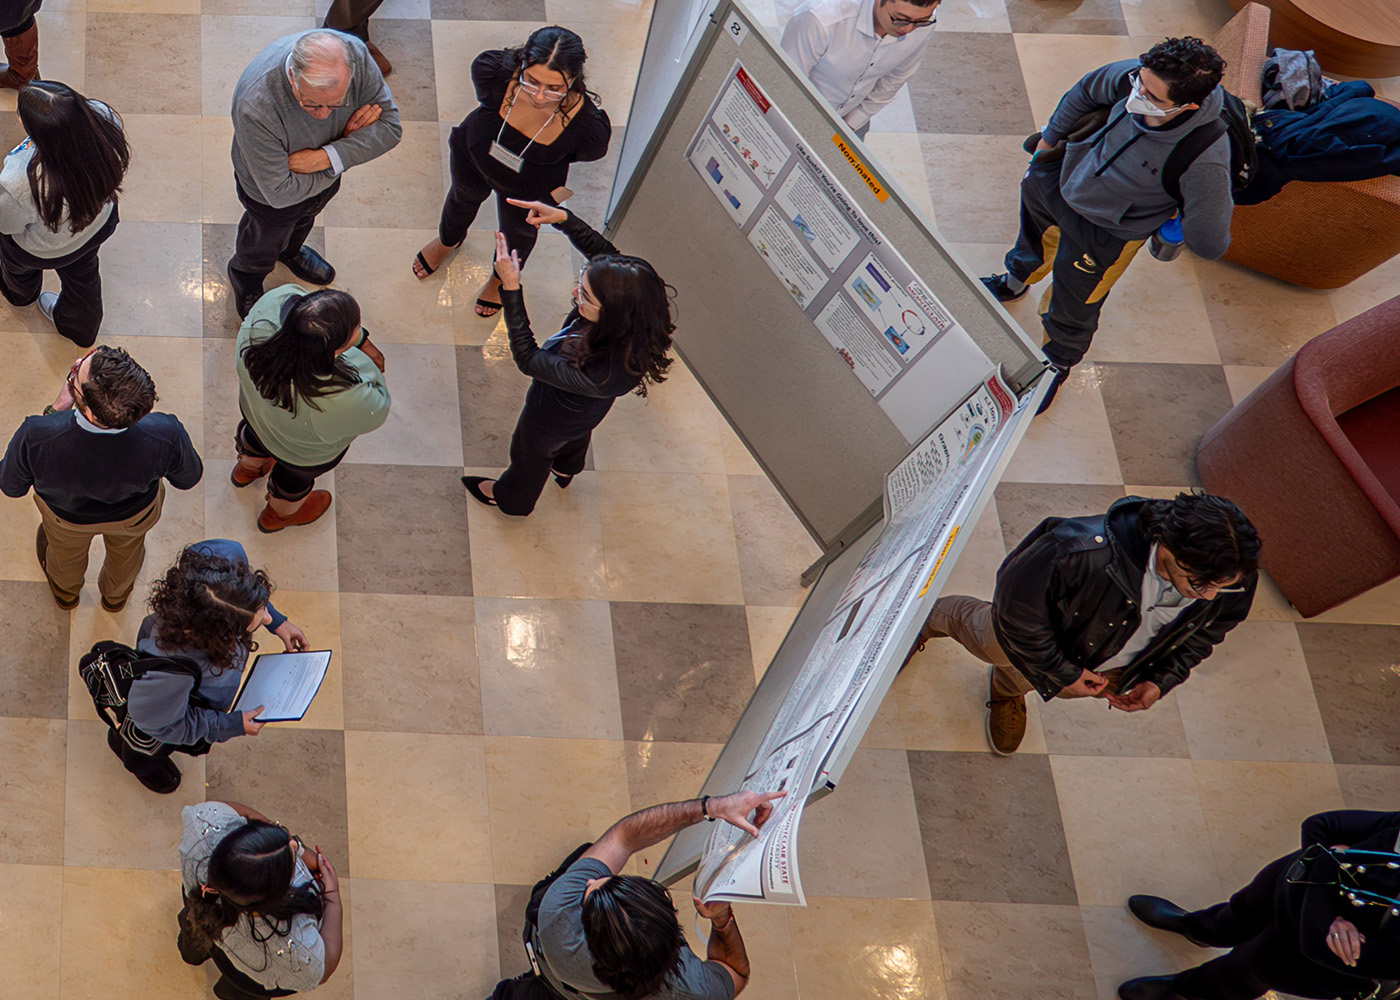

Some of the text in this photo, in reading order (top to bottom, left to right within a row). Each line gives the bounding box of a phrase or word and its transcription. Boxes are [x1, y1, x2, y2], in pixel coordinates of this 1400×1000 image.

[730, 22, 741, 35] 8
[794, 141, 806, 156] Like
[804, 153, 822, 175] Sushi?
[820, 173, 837, 194] You're
[835, 191, 852, 212] Going
[849, 208, 858, 219] To
[856, 216, 869, 232] love
[867, 229, 881, 246] this!
[838, 142, 881, 196] Nominated
[781, 813, 793, 884] MONTCLAIR STATE
